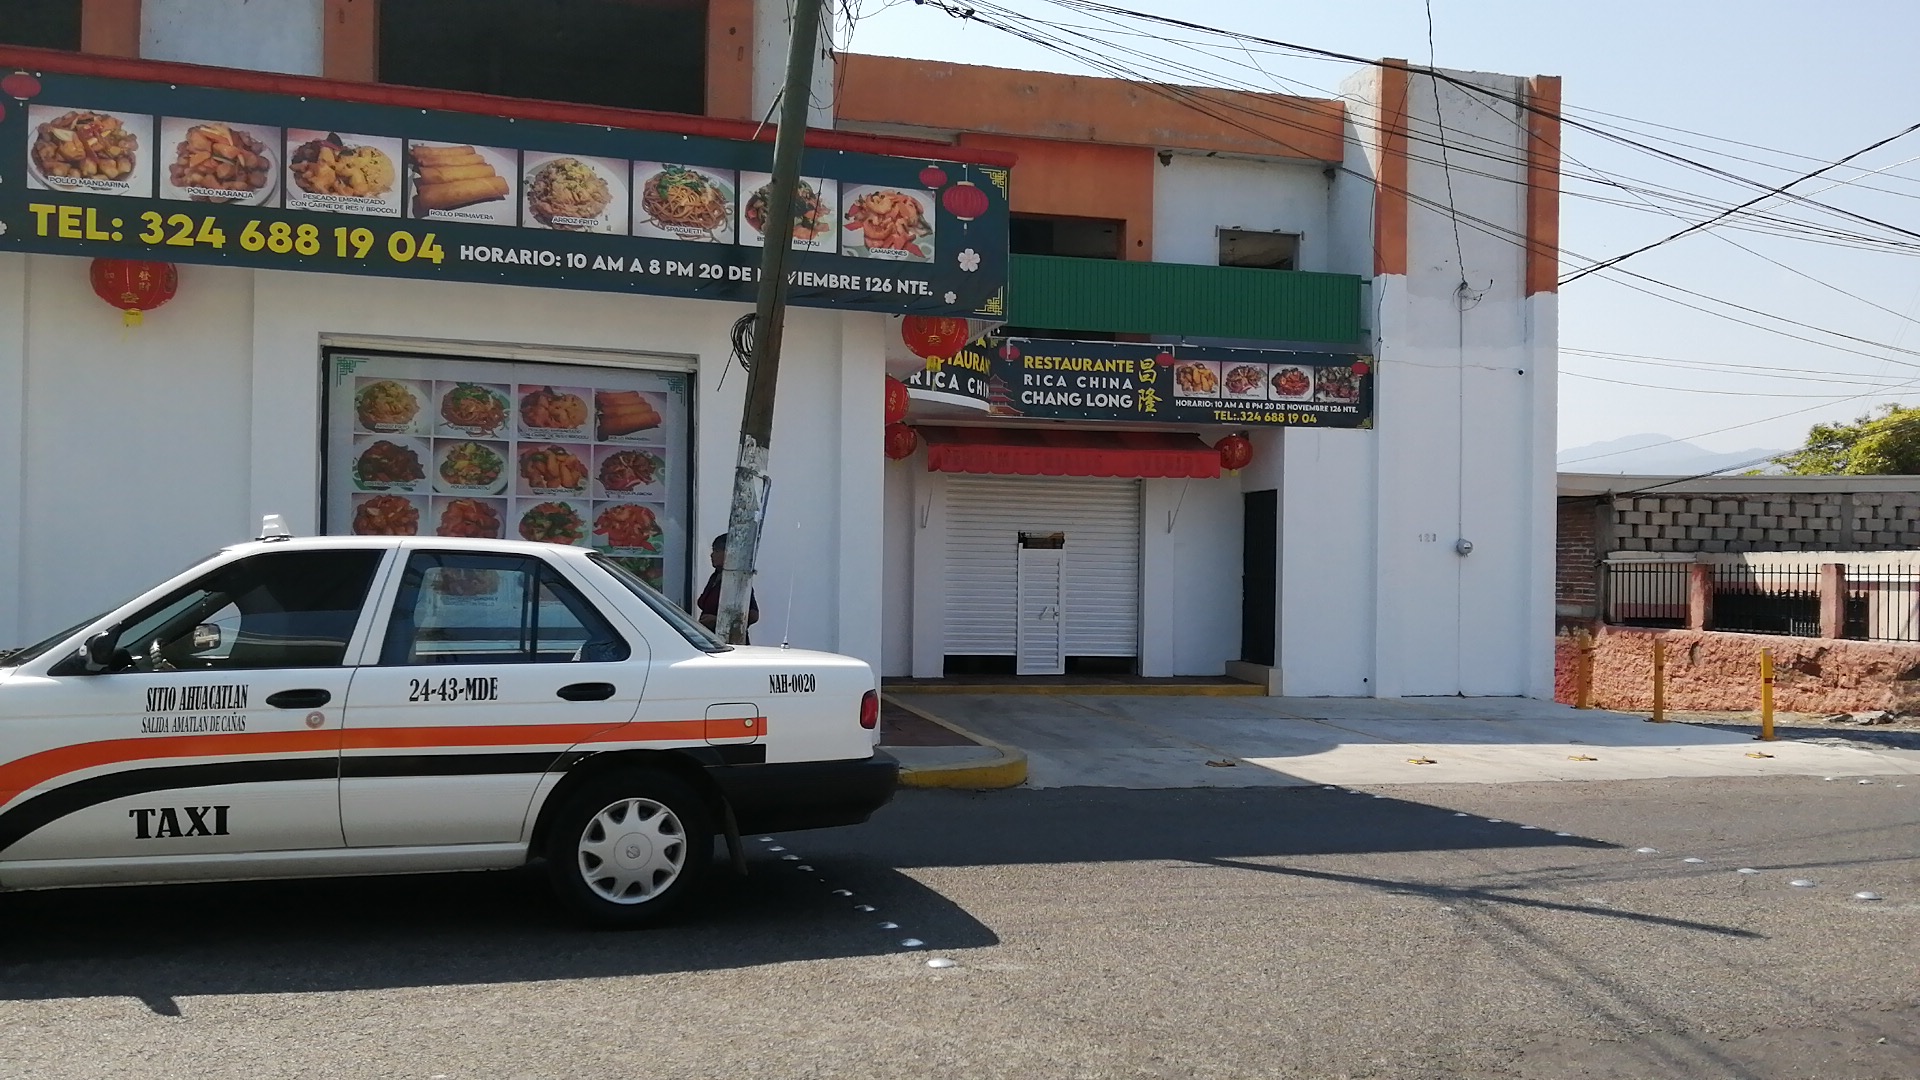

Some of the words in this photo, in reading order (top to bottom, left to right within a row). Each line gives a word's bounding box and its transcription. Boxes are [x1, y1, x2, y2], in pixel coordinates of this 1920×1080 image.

[49, 177, 77, 186] POLLO
[78, 179, 130, 189] MANDARINA
[187, 188, 215, 196] POLLO
[215, 190, 254, 199] NARANJA
[302, 193, 337, 202] PESCADO
[338, 196, 386, 206] EMPANIZADO
[291, 200, 307, 208] CON
[430, 210, 453, 218] ROLLO
[454, 212, 494, 220] PRIMAVERA
[552, 216, 577, 225] ARROZ
[578, 218, 599, 226] FRITO
[29, 203, 123, 242] TEL:
[139, 211, 226, 248] 324
[240, 220, 320, 256] 688
[334, 227, 374, 258] 19
[387, 230, 444, 264] 04
[665, 226, 702, 235] SPAGUETTI
[870, 248, 908, 257] CAMARONES
[460, 245, 561, 267] HORARIO:
[566, 253, 587, 269] 10
[592, 255, 623, 272] AM
[629, 258, 644, 273] A
[648, 260, 660, 275] 8
[666, 261, 693, 278] PM
[698, 264, 723, 280] 20
[728, 266, 751, 282] DE
[865, 277, 892, 293] 126
[897, 280, 934, 297] NTE.
[1024, 355, 1134, 373] RESTAURANTE
[1023, 374, 1067, 388] RICA
[1076, 376, 1133, 390] CHINA
[1137, 358, 1163, 413] 昌隆
[1021, 391, 1082, 407] CHANG
[1086, 393, 1133, 409] LONG
[1175, 400, 1214, 408] HORARIO:
[1286, 404, 1328, 412] NOVIEMBRE
[1264, 411, 1284, 423] 688
[1287, 412, 1298, 424] 19
[1301, 413, 1317, 424] 04
[409, 677, 498, 702] 24-43-MDE
[769, 673, 816, 693] NAH-0020
[146, 686, 176, 712] SITIO
[178, 684, 249, 711] AHUACATLAN
[141, 716, 169, 734] SALIDA
[171, 715, 210, 733] AMATLAN
[210, 715, 221, 732] DE
[221, 711, 247, 732] CAÑAS
[129, 805, 231, 839] TAXI
